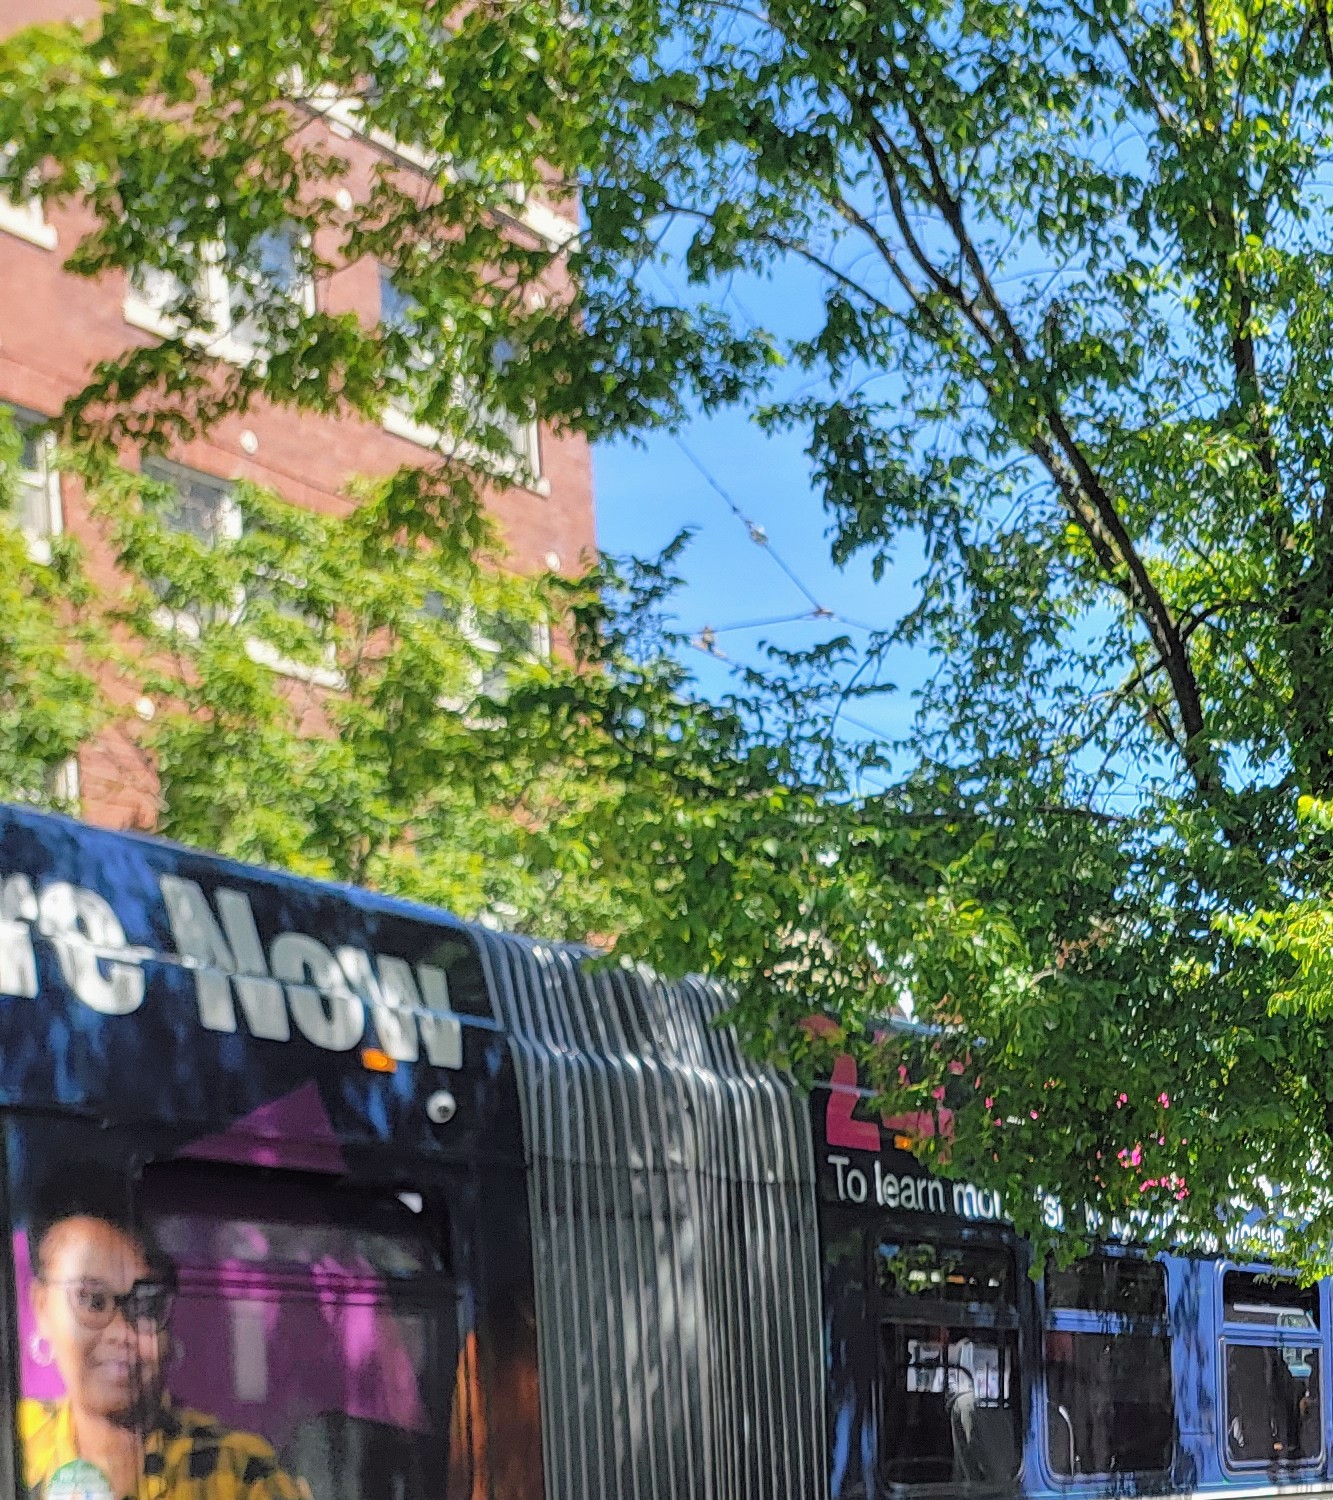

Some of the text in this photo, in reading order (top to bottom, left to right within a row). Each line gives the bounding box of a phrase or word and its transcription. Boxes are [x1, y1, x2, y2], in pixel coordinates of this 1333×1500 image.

[159, 873, 463, 1071] Now
[827, 1154, 868, 1204] To
[873, 1159, 946, 1213] learn
